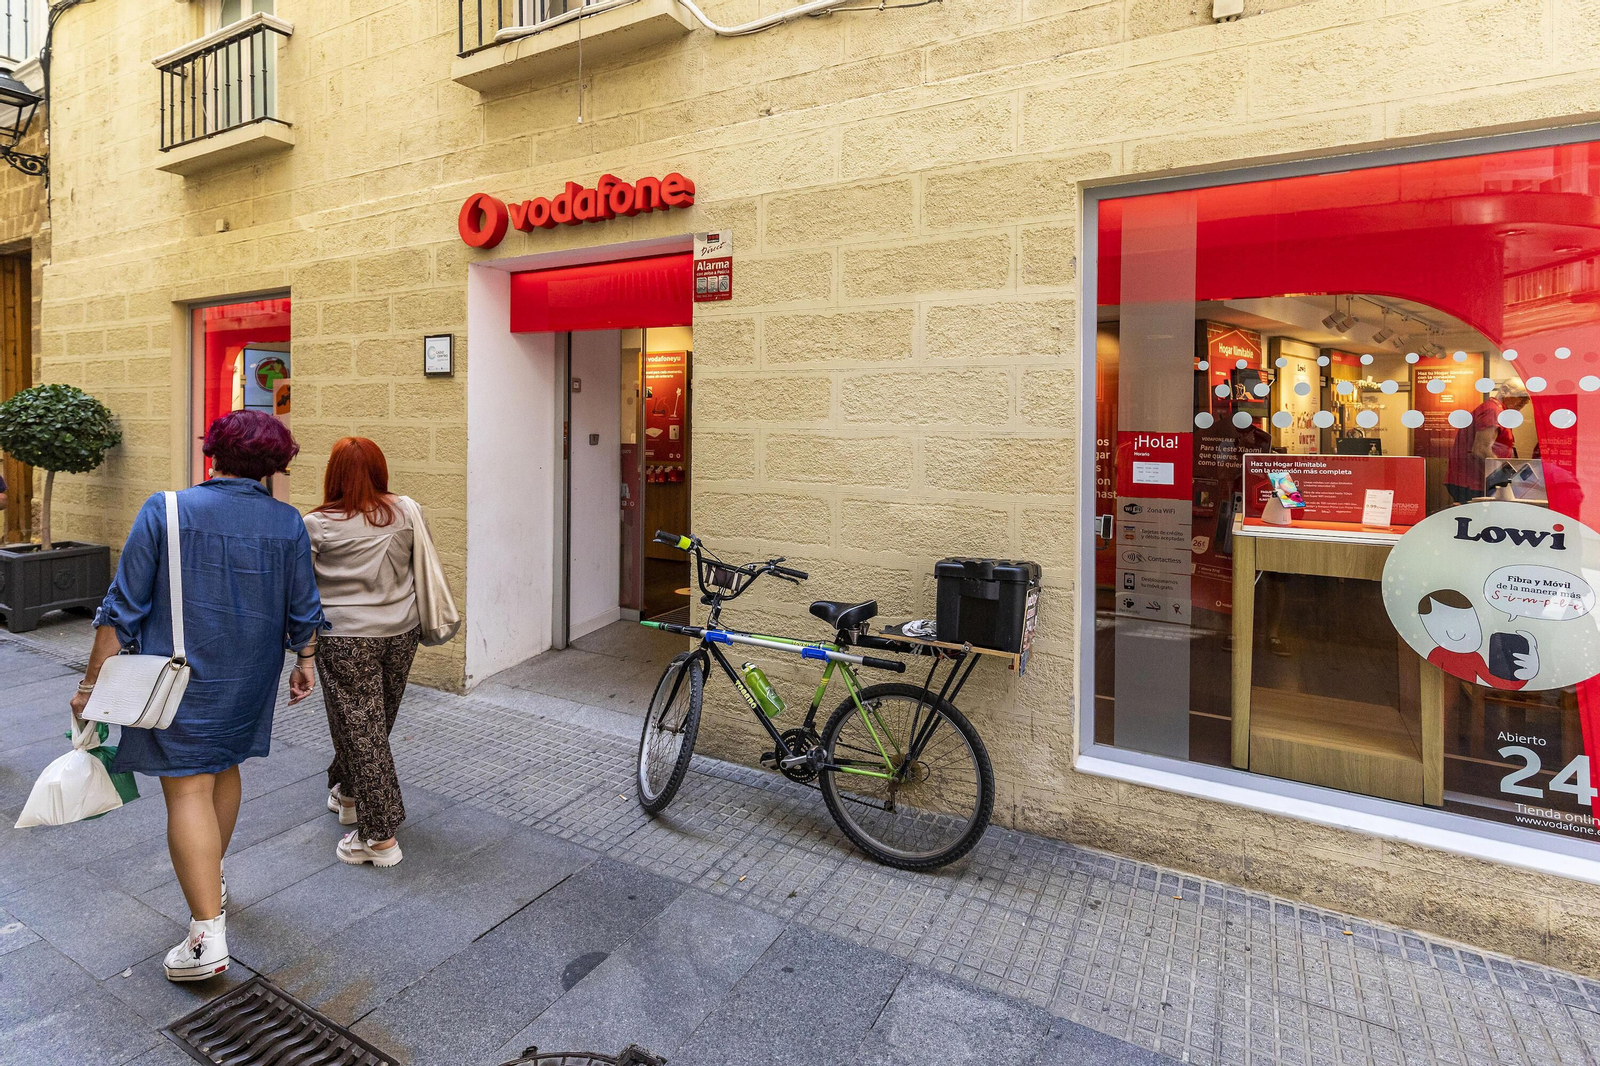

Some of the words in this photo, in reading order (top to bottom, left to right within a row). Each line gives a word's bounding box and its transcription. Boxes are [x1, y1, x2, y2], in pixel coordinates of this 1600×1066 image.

[508, 172, 695, 233] vodafone
[697, 260, 730, 271] Alarma
[1219, 342, 1233, 357] Hogar
[1233, 345, 1254, 359] Ilimitable
[1134, 434, 1178, 450] ¡Hola!
[1212, 453, 1239, 461] quieres,
[1271, 467, 1302, 475] conexión
[1273, 461, 1293, 469] Hogar
[1454, 517, 1566, 550] Lowi
[1147, 555, 1182, 564] Contactless
[1507, 575, 1532, 584] Fibra
[1534, 579, 1541, 587] y
[1543, 579, 1571, 589] Móvil
[1509, 583, 1519, 591] la
[1520, 585, 1558, 596] manera
[1560, 590, 1581, 599] más
[1497, 731, 1547, 746] Abierto
[1497, 745, 1598, 806] 24
[1515, 802, 1561, 819] Tienda
